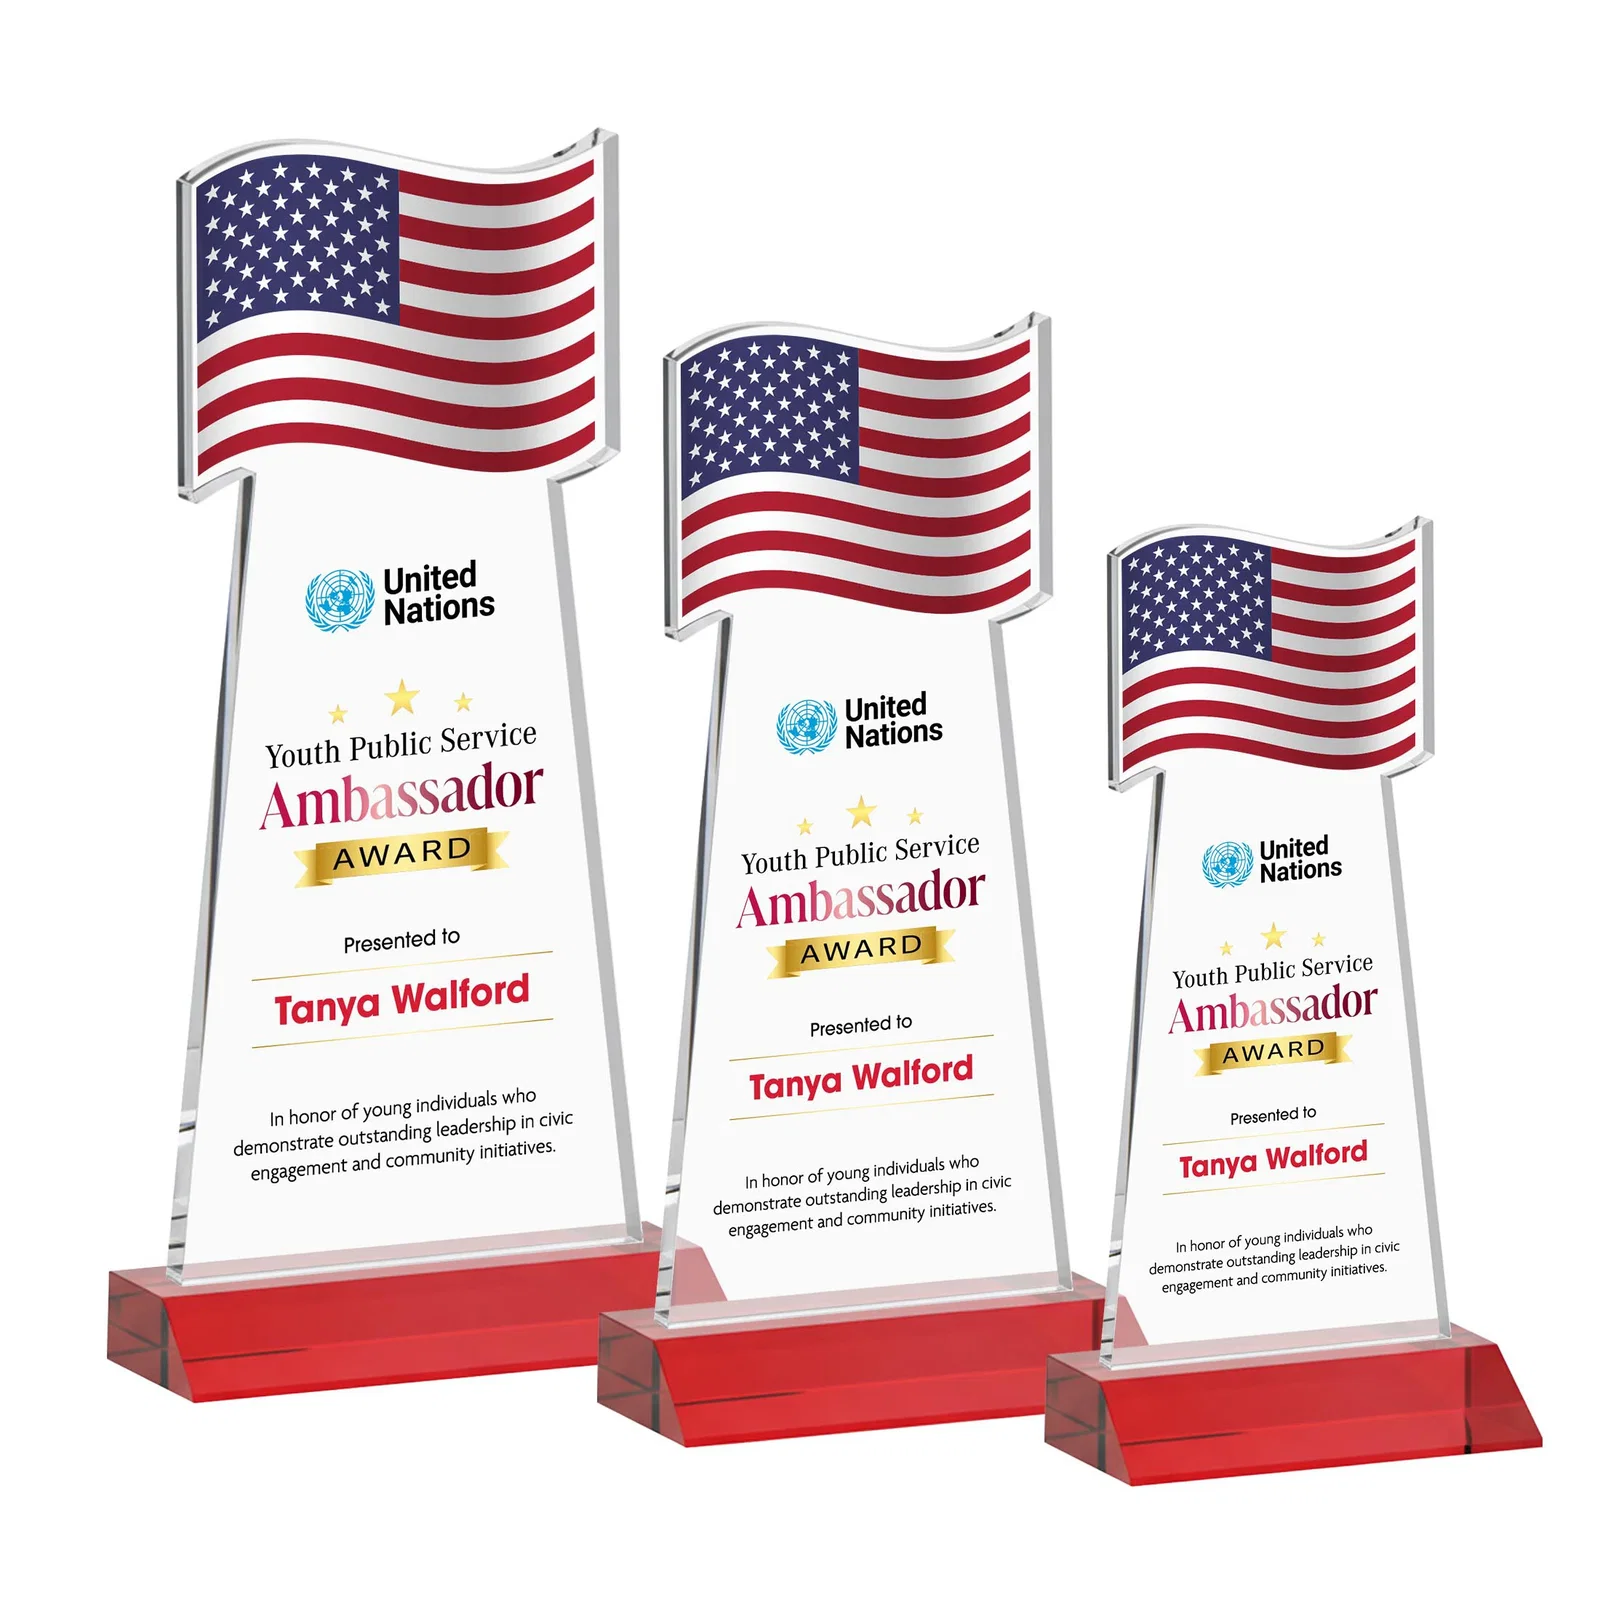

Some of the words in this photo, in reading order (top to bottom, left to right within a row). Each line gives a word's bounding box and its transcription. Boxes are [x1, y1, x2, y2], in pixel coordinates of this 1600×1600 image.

[384, 560, 476, 594] United
[385, 593, 495, 625] Nations
[845, 691, 927, 721] United
[265, 740, 340, 769] Youth
[350, 731, 432, 762] Public
[441, 723, 537, 752] Service
[846, 721, 943, 749] Nations
[259, 761, 544, 830] Ambassador
[333, 837, 471, 870] AWARD
[741, 849, 808, 875] Youth
[816, 841, 887, 868] Public
[895, 834, 980, 860] Service
[1260, 834, 1329, 860] United
[1260, 859, 1342, 883] Nations
[736, 868, 986, 929] Ambassador
[344, 930, 436, 953] Presented
[442, 928, 460, 945] to
[800, 934, 922, 964] AWARD
[1173, 967, 1228, 989] Youth
[1235, 961, 1295, 983] Public
[1302, 955, 1373, 977] Service
[275, 994, 379, 1026] Tanya
[392, 973, 529, 1014] Walford
[1168, 983, 1378, 1034] Ambassador
[810, 1016, 891, 1037] Presented
[896, 1014, 912, 1029] to
[1223, 1039, 1324, 1064] AWARD
[750, 1072, 841, 1101] Tanya
[852, 1054, 973, 1090] Walford
[270, 1112, 284, 1127] In
[289, 1109, 336, 1126] honor
[341, 1102, 360, 1121] of
[363, 1100, 411, 1122] young
[416, 1090, 497, 1113] individuals
[502, 1087, 536, 1104] who
[1231, 1107, 1299, 1125] Presented
[1303, 1106, 1316, 1119] to
[233, 1133, 334, 1157] demonstrate
[338, 1120, 432, 1146] outstanding
[436, 1116, 516, 1137] leadership
[521, 1115, 534, 1129] in
[539, 1111, 573, 1127] civic
[251, 1159, 347, 1184] engagement
[352, 1154, 380, 1171] and
[386, 1147, 475, 1168] community
[480, 1140, 556, 1159] initiatives.
[746, 1176, 757, 1189] In
[762, 1173, 803, 1188] honor
[808, 1168, 824, 1183] of
[827, 1166, 869, 1185] young
[873, 1157, 945, 1177] individuals
[949, 1154, 979, 1169] who
[1180, 1154, 1257, 1179] Tanya
[1266, 1139, 1367, 1170] Walford
[713, 1195, 802, 1215] demonstrate
[806, 1184, 887, 1206] outstanding
[891, 1179, 961, 1198] leadership
[966, 1179, 977, 1191] in
[982, 1175, 1011, 1189] civic
[729, 1218, 813, 1239] engagement
[818, 1212, 842, 1228] and
[847, 1207, 925, 1225] community
[930, 1201, 996, 1217] initiatives.
[1176, 1242, 1187, 1253] In
[1190, 1240, 1225, 1251] honor
[1228, 1235, 1242, 1248] of
[1245, 1234, 1280, 1250] young
[1284, 1226, 1344, 1243] individuals
[1347, 1224, 1373, 1236] who
[1149, 1258, 1223, 1275] demonstrate
[1227, 1249, 1295, 1267] outstanding
[1299, 1245, 1358, 1260] leadership
[1361, 1244, 1371, 1255] in
[1375, 1241, 1400, 1253] civic
[1162, 1276, 1233, 1295] engagement
[1237, 1272, 1258, 1286] and
[1261, 1267, 1327, 1283] community
[1331, 1263, 1387, 1277] initiatives.
